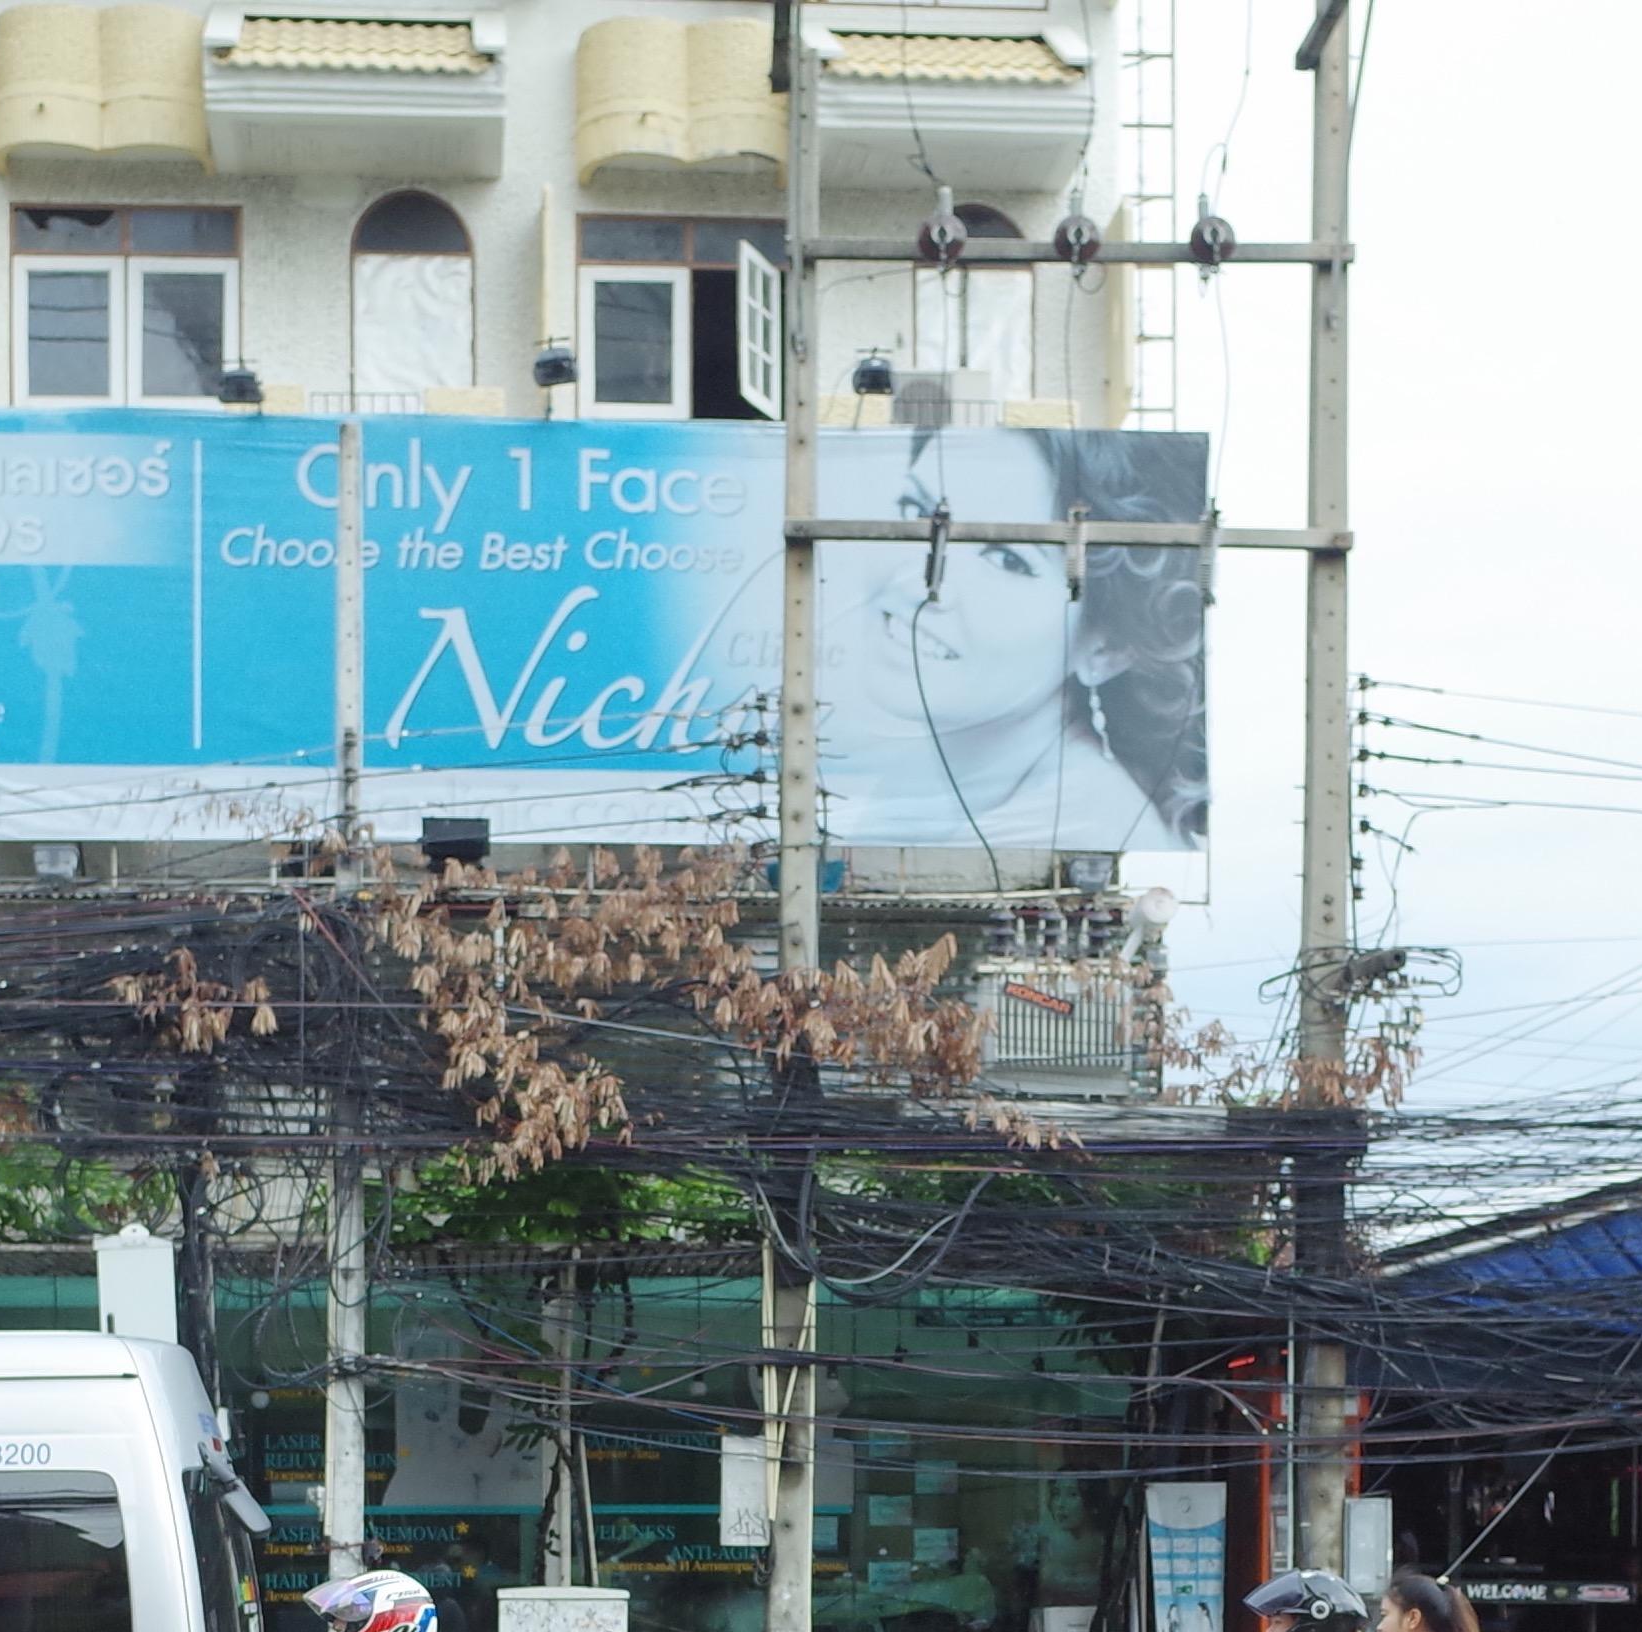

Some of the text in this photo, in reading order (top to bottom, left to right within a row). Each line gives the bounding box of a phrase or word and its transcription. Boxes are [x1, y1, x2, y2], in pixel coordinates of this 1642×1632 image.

[296, 438, 747, 533] Only 1 Face
[220, 524, 746, 574] Chooe the Best Choose
[263, 1434, 321, 1449] LASER
[1466, 1583, 1548, 1600] WELCOME
